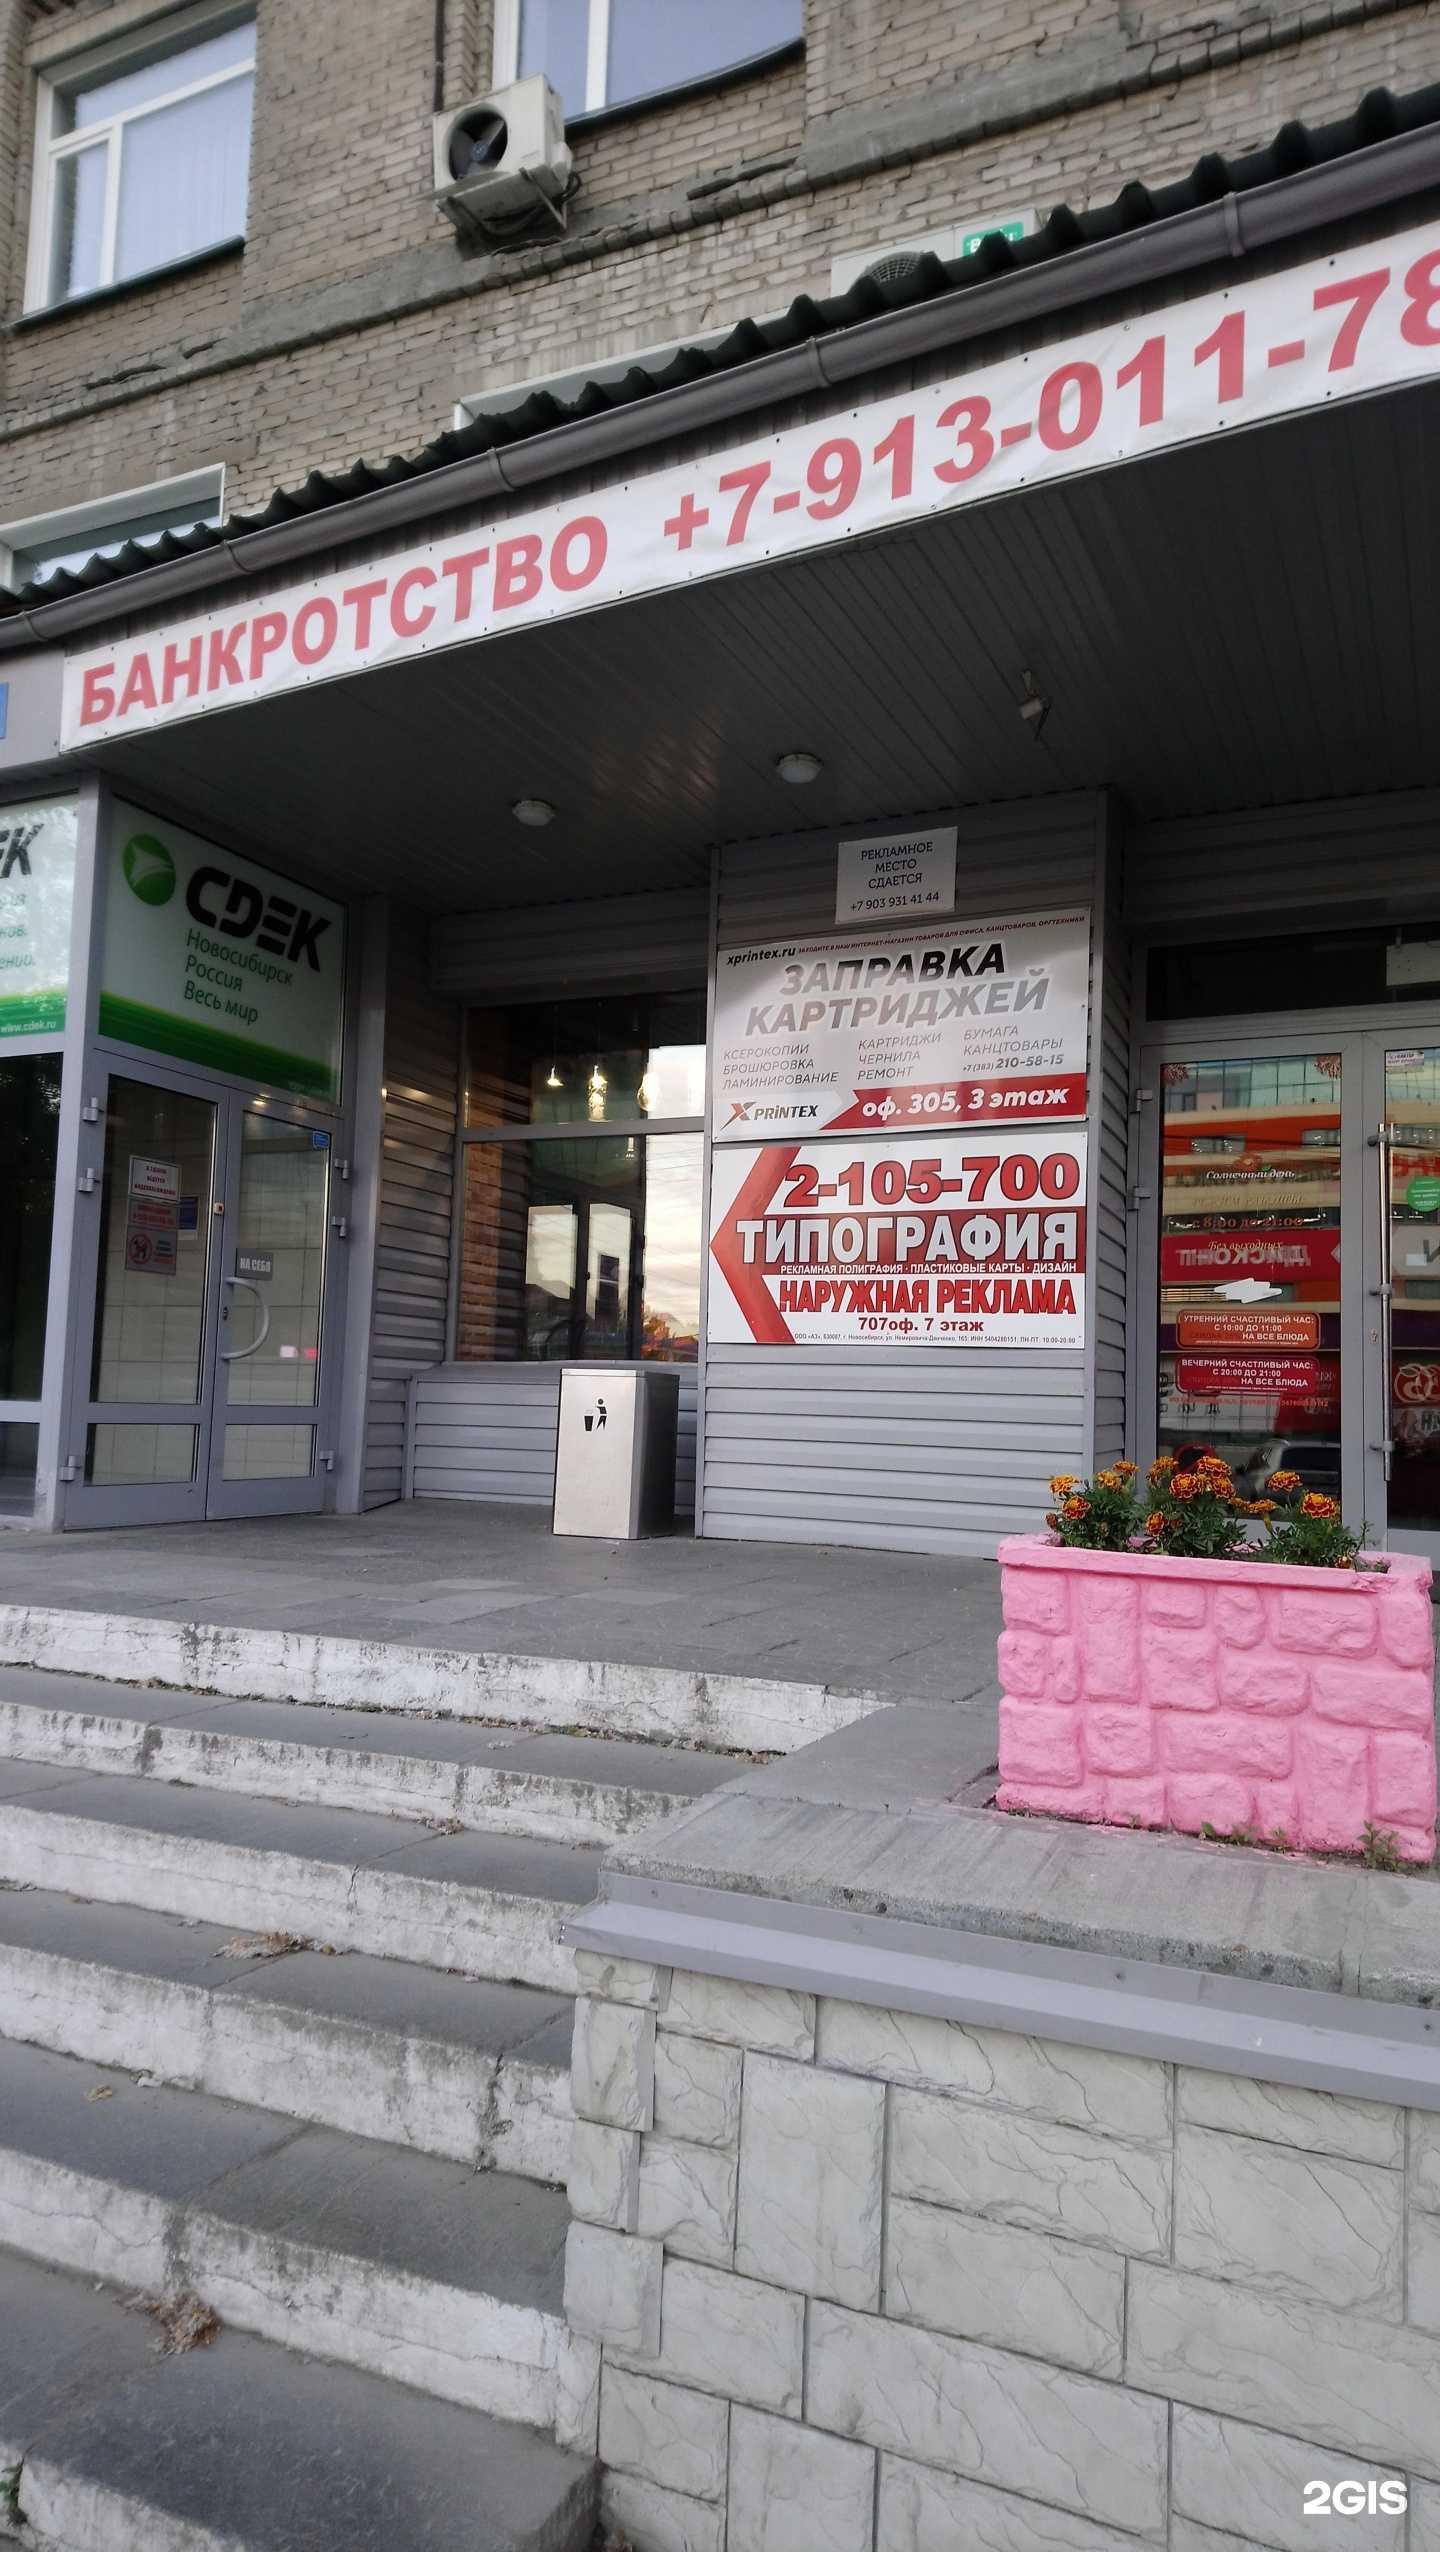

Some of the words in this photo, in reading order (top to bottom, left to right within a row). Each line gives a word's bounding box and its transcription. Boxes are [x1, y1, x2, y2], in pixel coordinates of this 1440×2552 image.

[79, 515, 608, 727] БАНКРОТСТВО
[861, 842, 933, 861] РЕКЛАМНОЕ
[875, 859, 917, 873] МЕСТО
[868, 873, 922, 889] СДАЕТСЯ
[850, 900, 863, 912] +7
[865, 898, 886, 910] 903
[889, 895, 908, 907] 931
[910, 894, 922, 904] 41
[926, 891, 939, 902] 44
[186, 866, 332, 973] CDEK
[186, 928, 294, 987] Новосибирск
[727, 947, 796, 967] xprintex.ru
[913, 932, 944, 943] ТОВАРОВ
[944, 930, 959, 939] ДЛЯ
[185, 954, 243, 992] Россия
[780, 943, 1005, 995] ЗАПРАВКА
[184, 980, 222, 1010] Весь
[224, 1001, 259, 1026] мир
[745, 967, 1050, 1036] КАРТРИДЖЕЙ
[1, 1019, 57, 1033] www.cdek.ru
[964, 1025, 1018, 1040] БУМАГА
[858, 1032, 942, 1050] КАРТРИДЖИ
[963, 1038, 1063, 1057] КАНЦТОВАРЫ
[724, 1044, 810, 1061] КСЕРОКОПИИ
[858, 1051, 921, 1065] ЧЕРНИЛА
[723, 1058, 814, 1075] БРОШЮРОВКА
[995, 1054, 1064, 1070] 210-58-15
[722, 1071, 839, 1090] ЛАМИНИРОВАНИЕ
[857, 1066, 914, 1081] РЕМОНТ
[862, 1096, 902, 1121] оф.
[907, 1090, 961, 1114] 305,
[968, 1087, 985, 1110] 3
[989, 1087, 1070, 1109] этаж
[783, 1152, 1080, 1208] 2-105-700
[735, 1211, 1078, 1264] ТИПОГРАФИЯ
[780, 1264, 836, 1275] РЕКЛАМНАЯ
[838, 1263, 903, 1275] ПОЛИГРАФИЯ
[910, 1263, 988, 1274] ПЛАСТИКОВЫЕ
[989, 1263, 1025, 1273] КАРТЫ
[1033, 1261, 1076, 1274] ДИЗАЙН
[780, 1279, 930, 1313] НАРУЖНАЯ
[937, 1279, 1076, 1314] РЕКЛАМА
[858, 1316, 918, 1334] 707оф.
[924, 1317, 934, 1331] 7
[940, 1320, 984, 1332] этаж
[1184, 1313, 1228, 1323] УТРЕННИЙ
[1230, 1313, 1291, 1324] СЧАСТЛИВЫЙ
[1293, 1316, 1314, 1324] ЧАС:
[1223, 1324, 1244, 1332] 10:00
[1261, 1324, 1282, 1332] 11:00
[1242, 1333, 1254, 1341] НА
[1257, 1333, 1274, 1341] ВСЕ
[1276, 1333, 1309, 1342] БЛЮДА
[1182, 1358, 1227, 1367] ВЕЧЕРНИЙ
[1230, 1359, 1290, 1369] СЧАСТЛИВЫЙ
[1293, 1361, 1313, 1369] ЧАС:
[1244, 1369, 1257, 1377] ДО
[1259, 1369, 1281, 1377] 21:00
[1275, 1378, 1308, 1387] БЛЮДА
